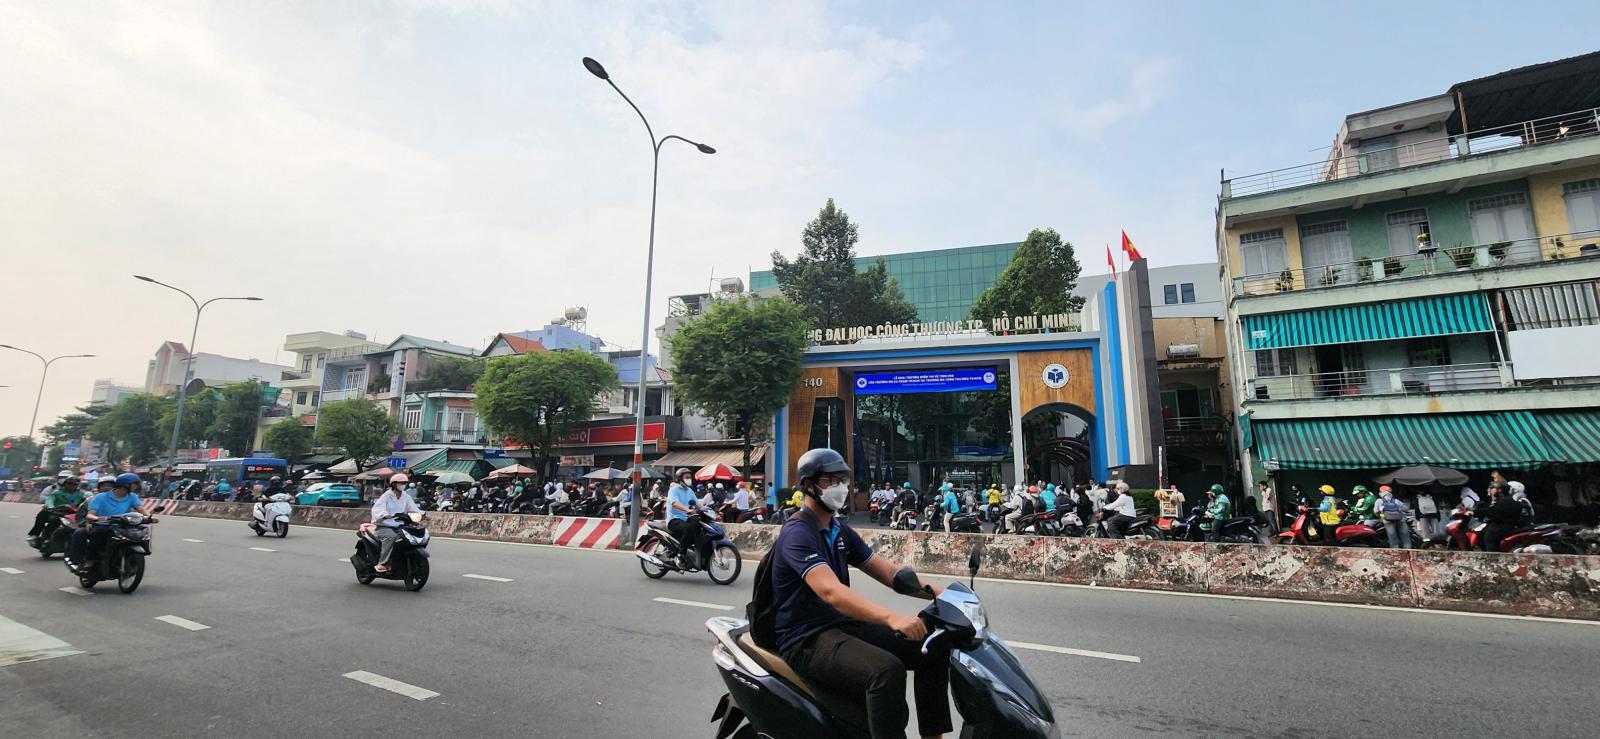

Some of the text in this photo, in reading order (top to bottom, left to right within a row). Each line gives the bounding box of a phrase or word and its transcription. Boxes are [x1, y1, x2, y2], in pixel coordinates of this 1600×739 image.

[825, 327, 846, 344] ĐẠI
[876, 321, 909, 338] CÔNG
[911, 319, 963, 336] THƯƠNG
[992, 310, 1010, 331] HỒ
[1014, 311, 1039, 330] CHÍ
